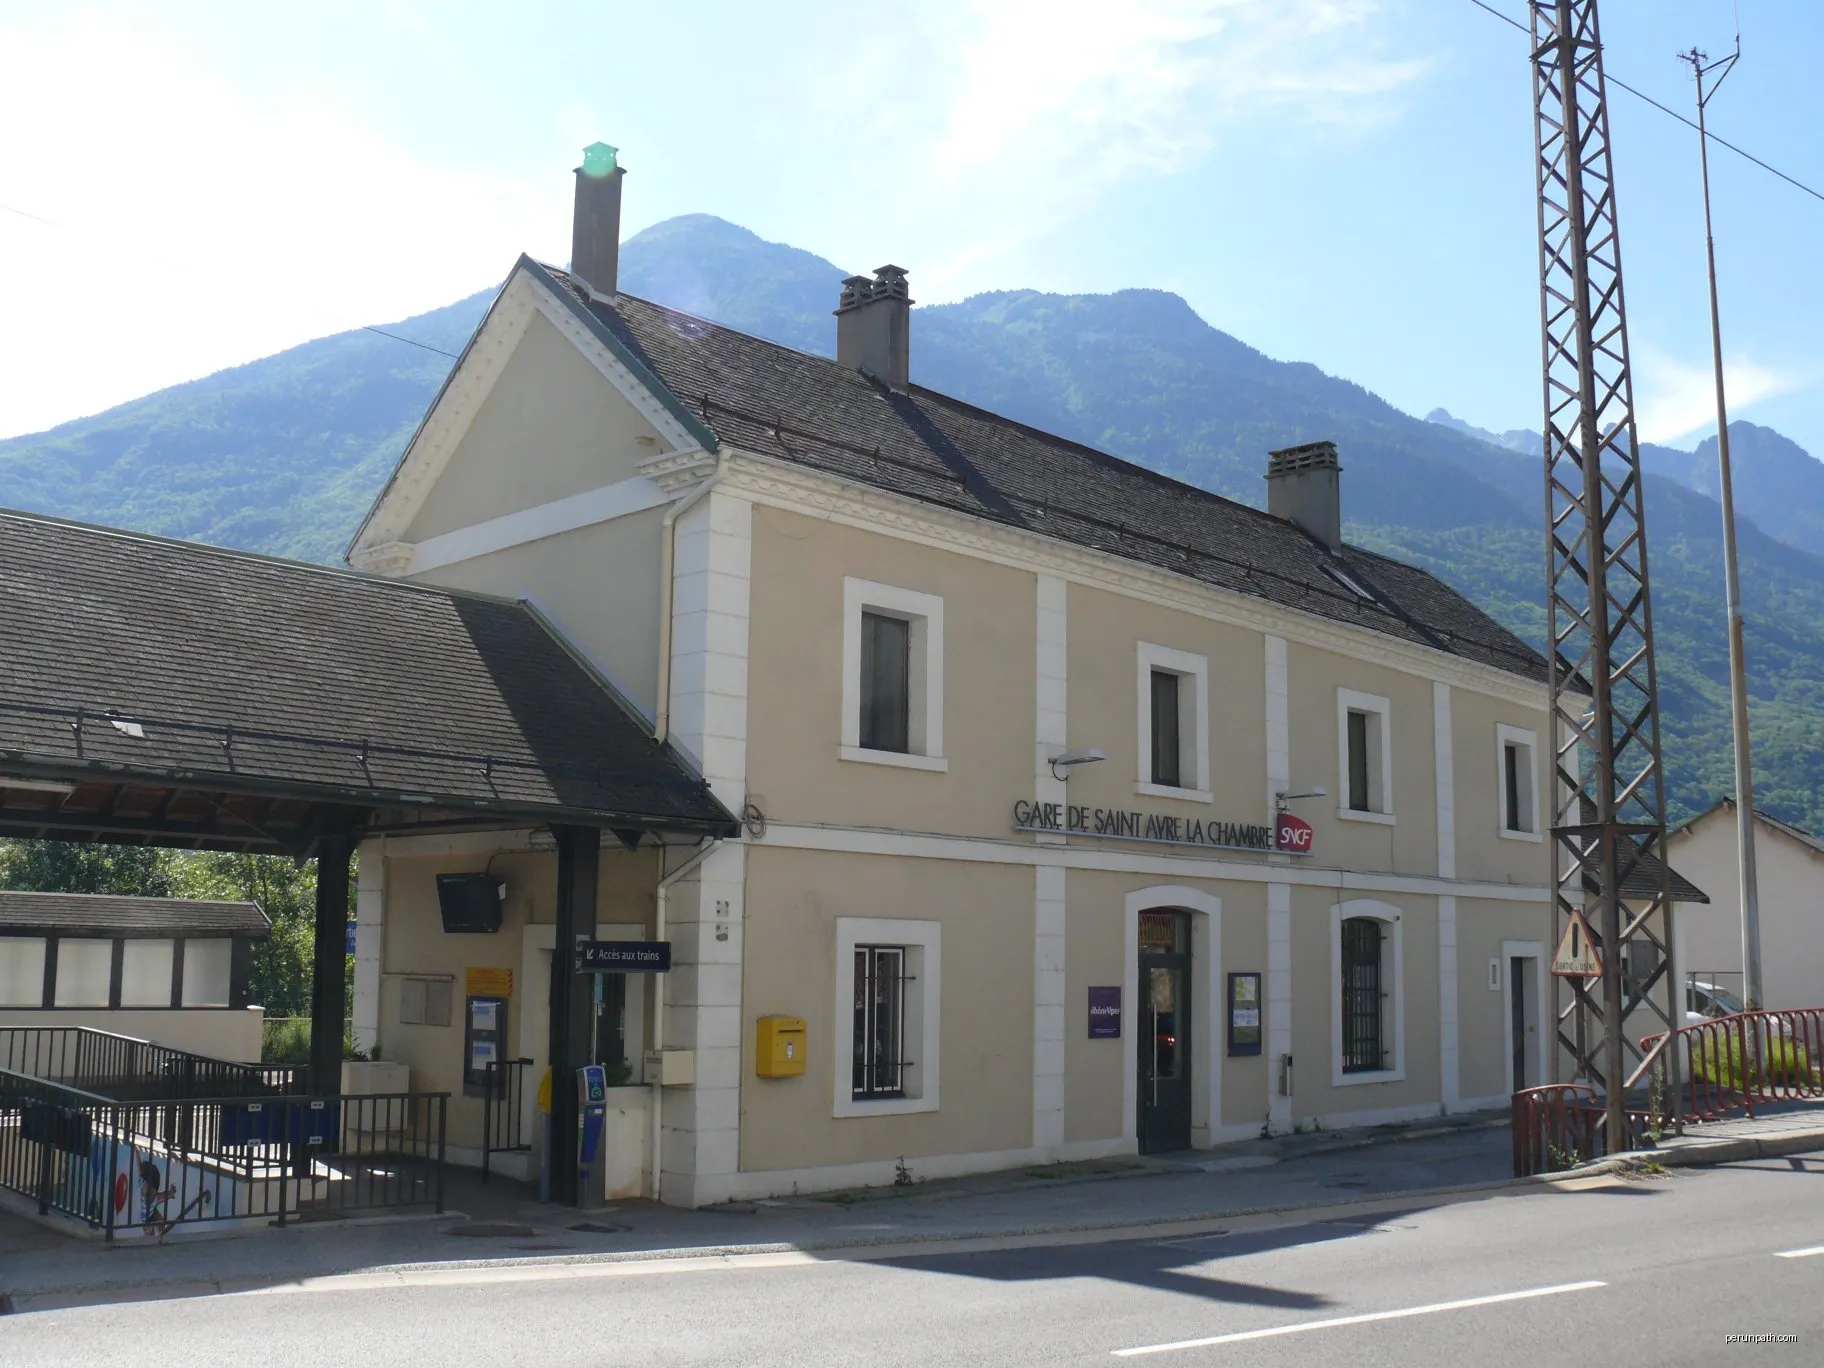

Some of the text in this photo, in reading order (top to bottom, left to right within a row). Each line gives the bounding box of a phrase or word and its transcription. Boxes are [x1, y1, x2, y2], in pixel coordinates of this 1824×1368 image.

[1014, 800, 1273, 849] GARE DE SAINT AVRE LA CHAMBRE
[1280, 827, 1312, 845] SNCF
[598, 948, 660, 961] Accès aux trains
